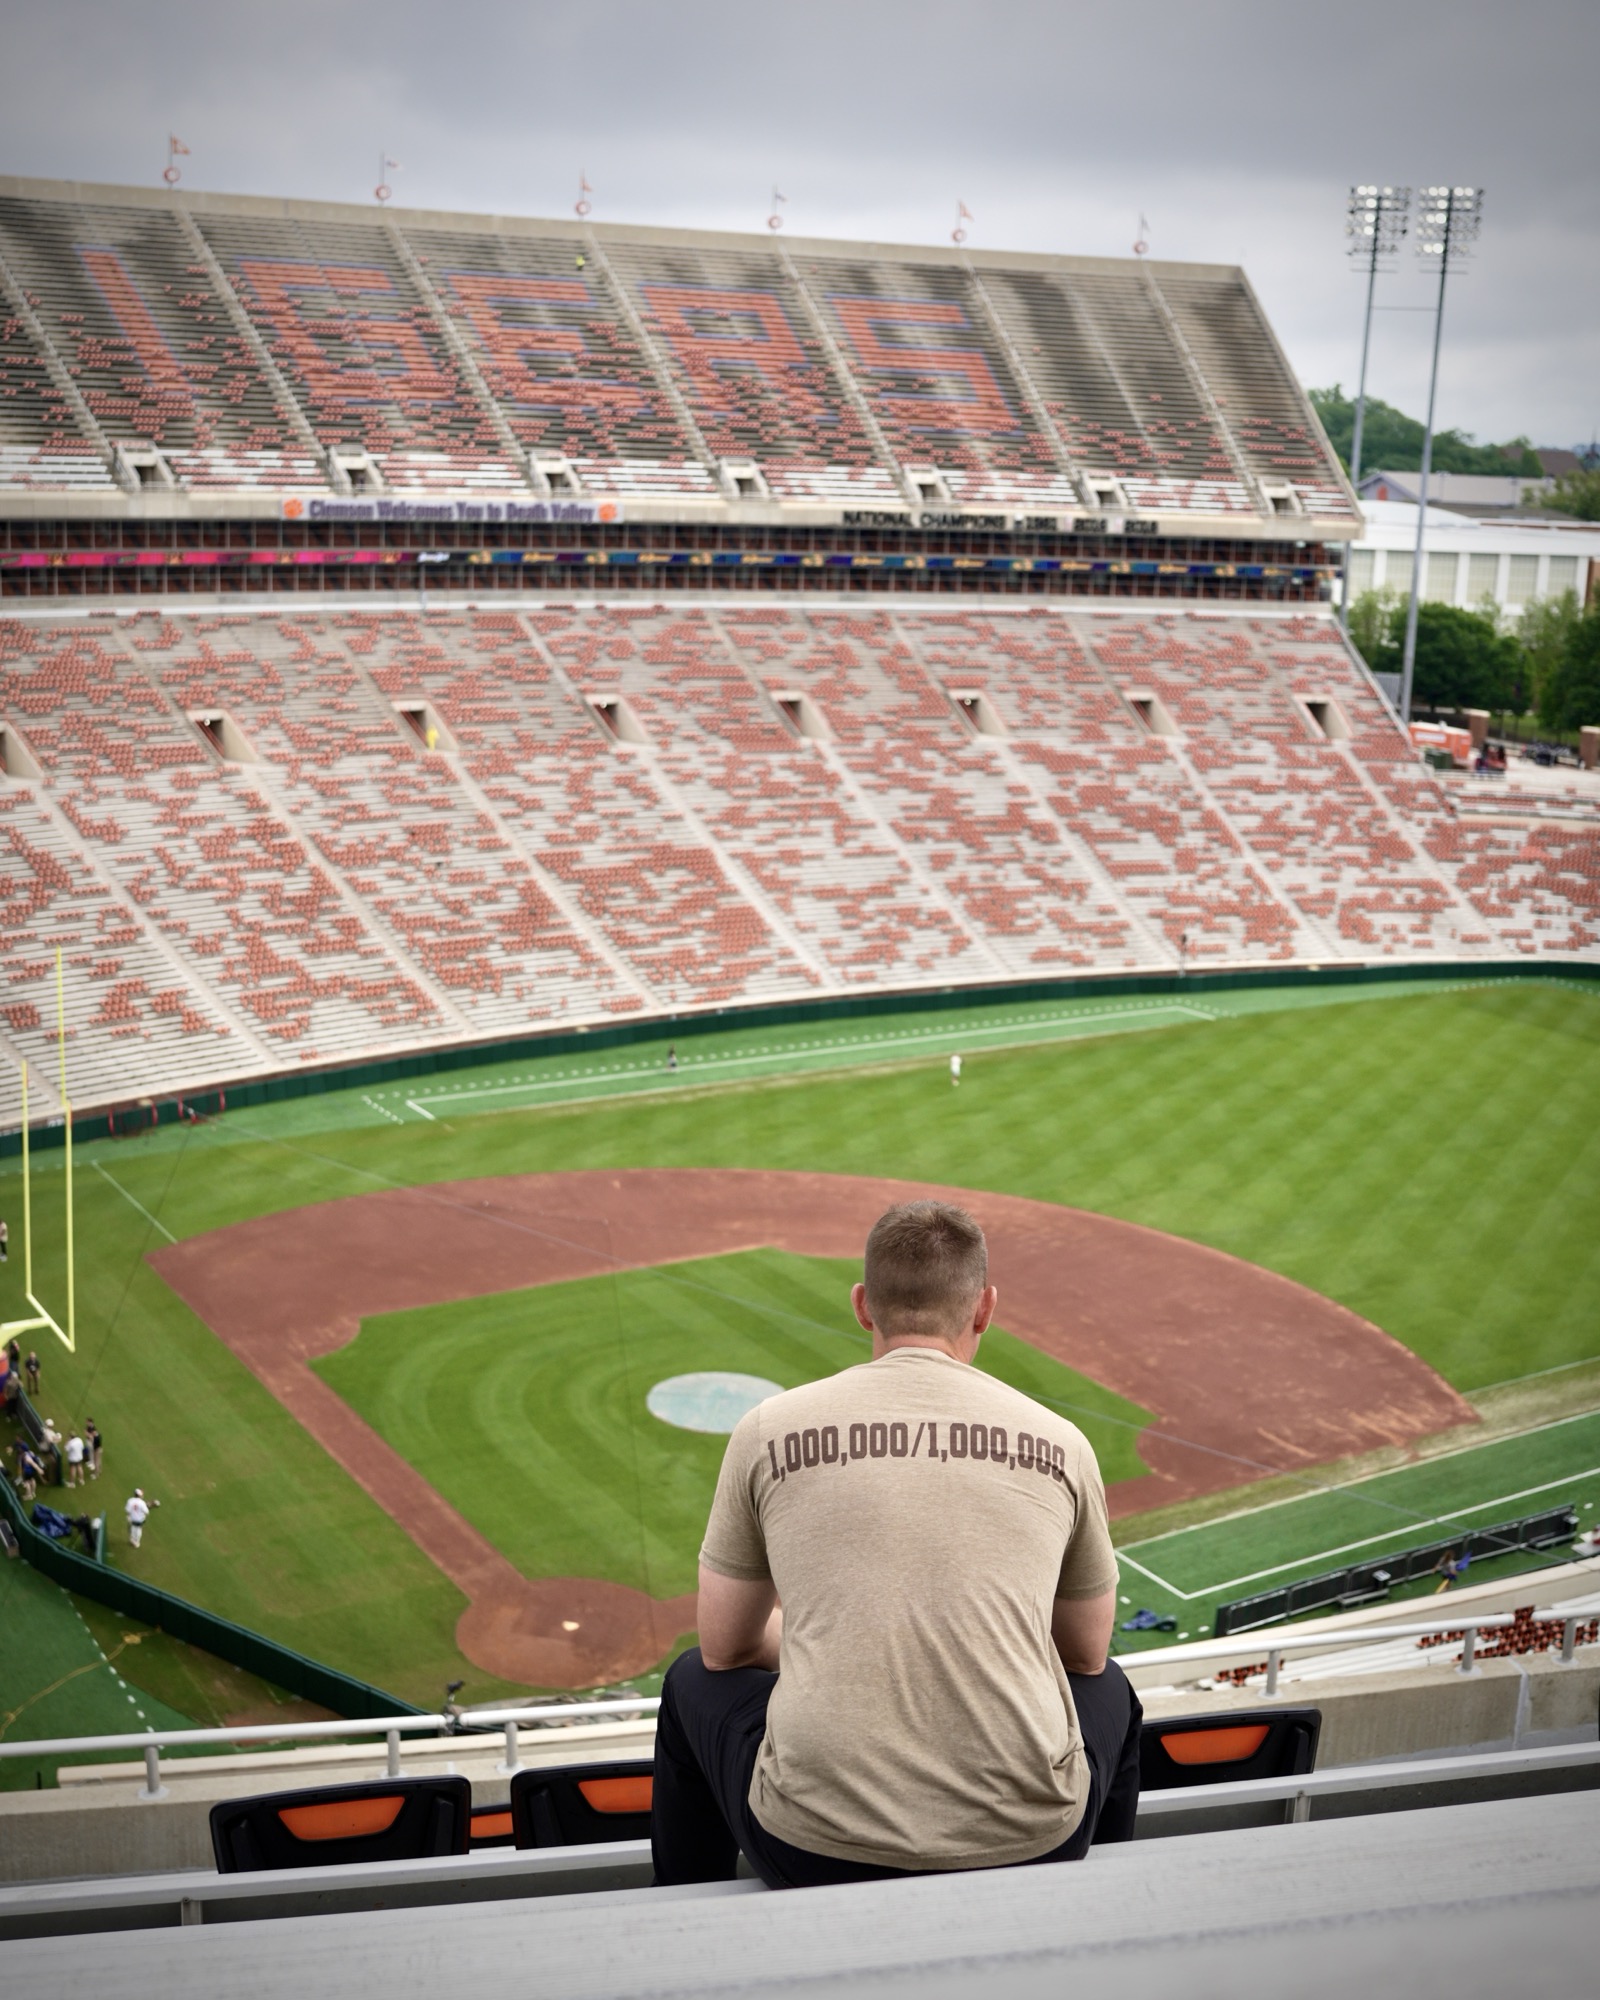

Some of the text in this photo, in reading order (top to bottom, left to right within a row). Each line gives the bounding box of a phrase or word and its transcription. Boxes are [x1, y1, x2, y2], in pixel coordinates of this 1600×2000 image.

[309, 500, 594, 523] Clemson Welcomes You to Death Valley
[843, 511, 914, 528] NATIONAL
[920, 513, 1006, 531] CHAMPIONS
[767, 1422, 1066, 1483] 1,000,000/1,000,000
